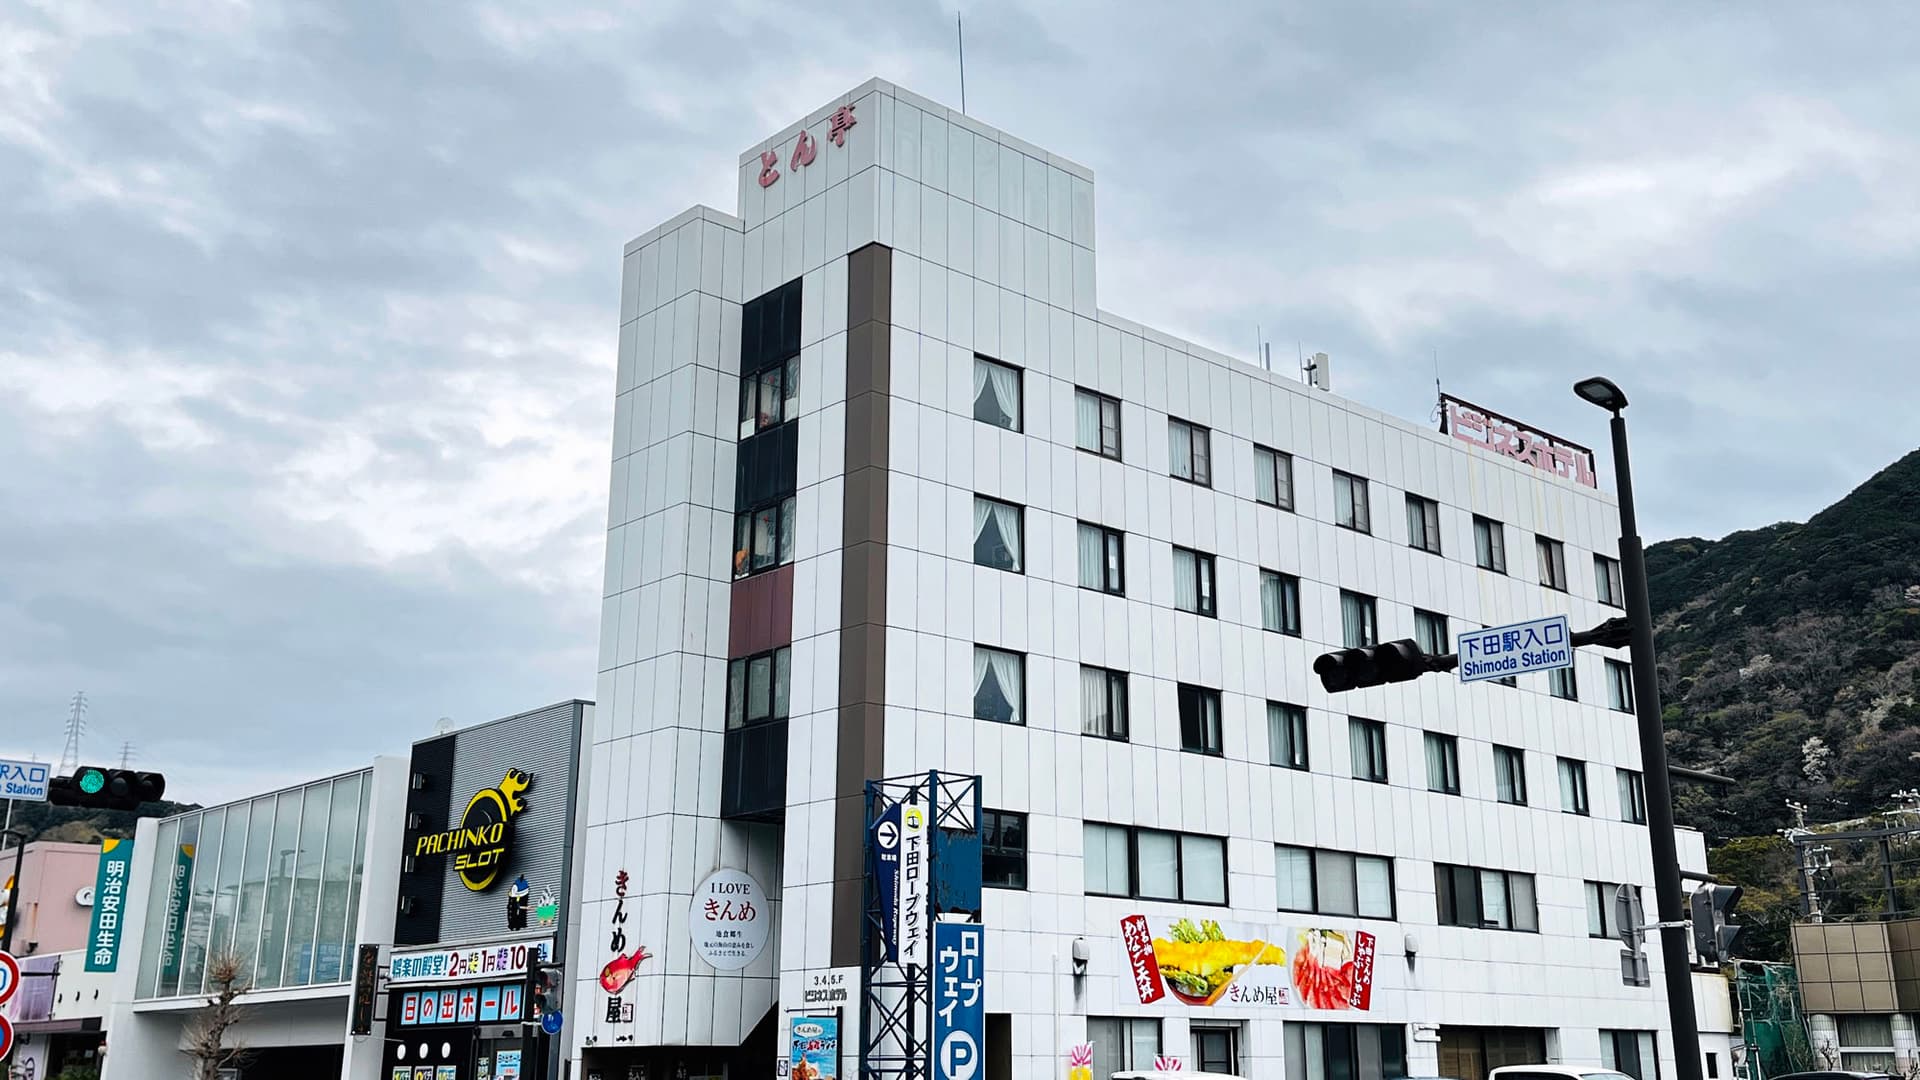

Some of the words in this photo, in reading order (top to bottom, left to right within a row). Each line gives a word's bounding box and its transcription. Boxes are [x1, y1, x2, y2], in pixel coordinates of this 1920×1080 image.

[758, 104, 857, 188] とん亭
[1450, 404, 1595, 488] ビジネスホテル
[1462, 623, 1563, 658] 下田駅入口
[1464, 655, 1517, 676] Shimoda
[1521, 648, 1566, 668] Station
[5, 782, 44, 796] Station
[415, 822, 504, 857] PACHINKO
[454, 847, 505, 870] SLOT
[711, 882, 716, 894] I
[718, 882, 751, 895] LOVE
[903, 835, 922, 957] 下田ロープウェイ
[94, 860, 126, 966] 明治安田生命
[703, 897, 757, 922] きんめ
[938, 945, 959, 1027] ウェイ
[961, 931, 982, 1007] ロープ
[405, 990, 518, 1021] 日の出ホール
[1229, 982, 1278, 1005] きんめ屋
